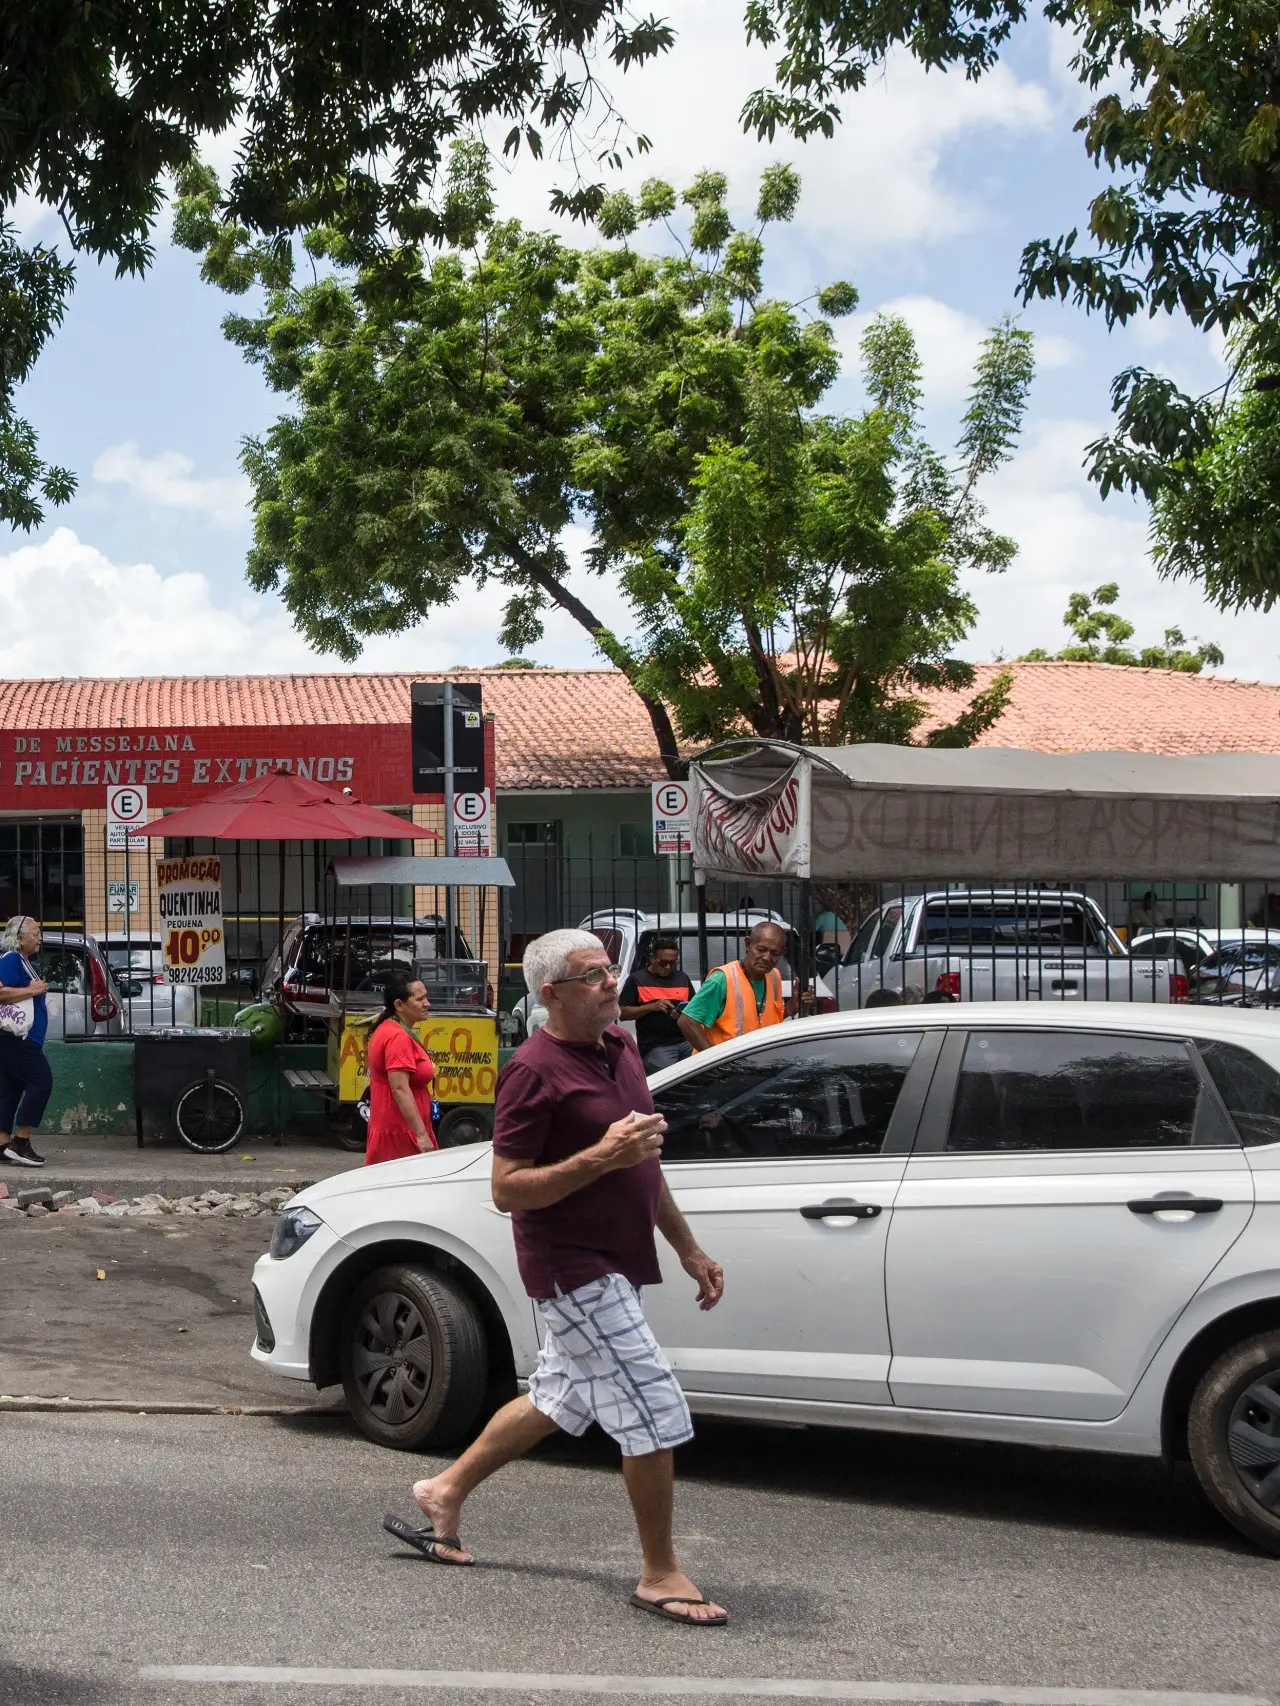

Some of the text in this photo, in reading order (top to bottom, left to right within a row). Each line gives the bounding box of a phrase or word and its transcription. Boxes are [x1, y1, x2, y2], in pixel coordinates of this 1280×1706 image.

[14, 737, 41, 753] DE
[55, 735, 196, 753] MESSEJANA
[121, 796, 133, 813] E
[464, 797, 476, 815] E
[666, 791, 678, 809] E
[157, 858, 220, 886] PROMOÇÃO
[160, 891, 220, 918] QUENTINHA
[167, 920, 203, 928] PEQUENA
